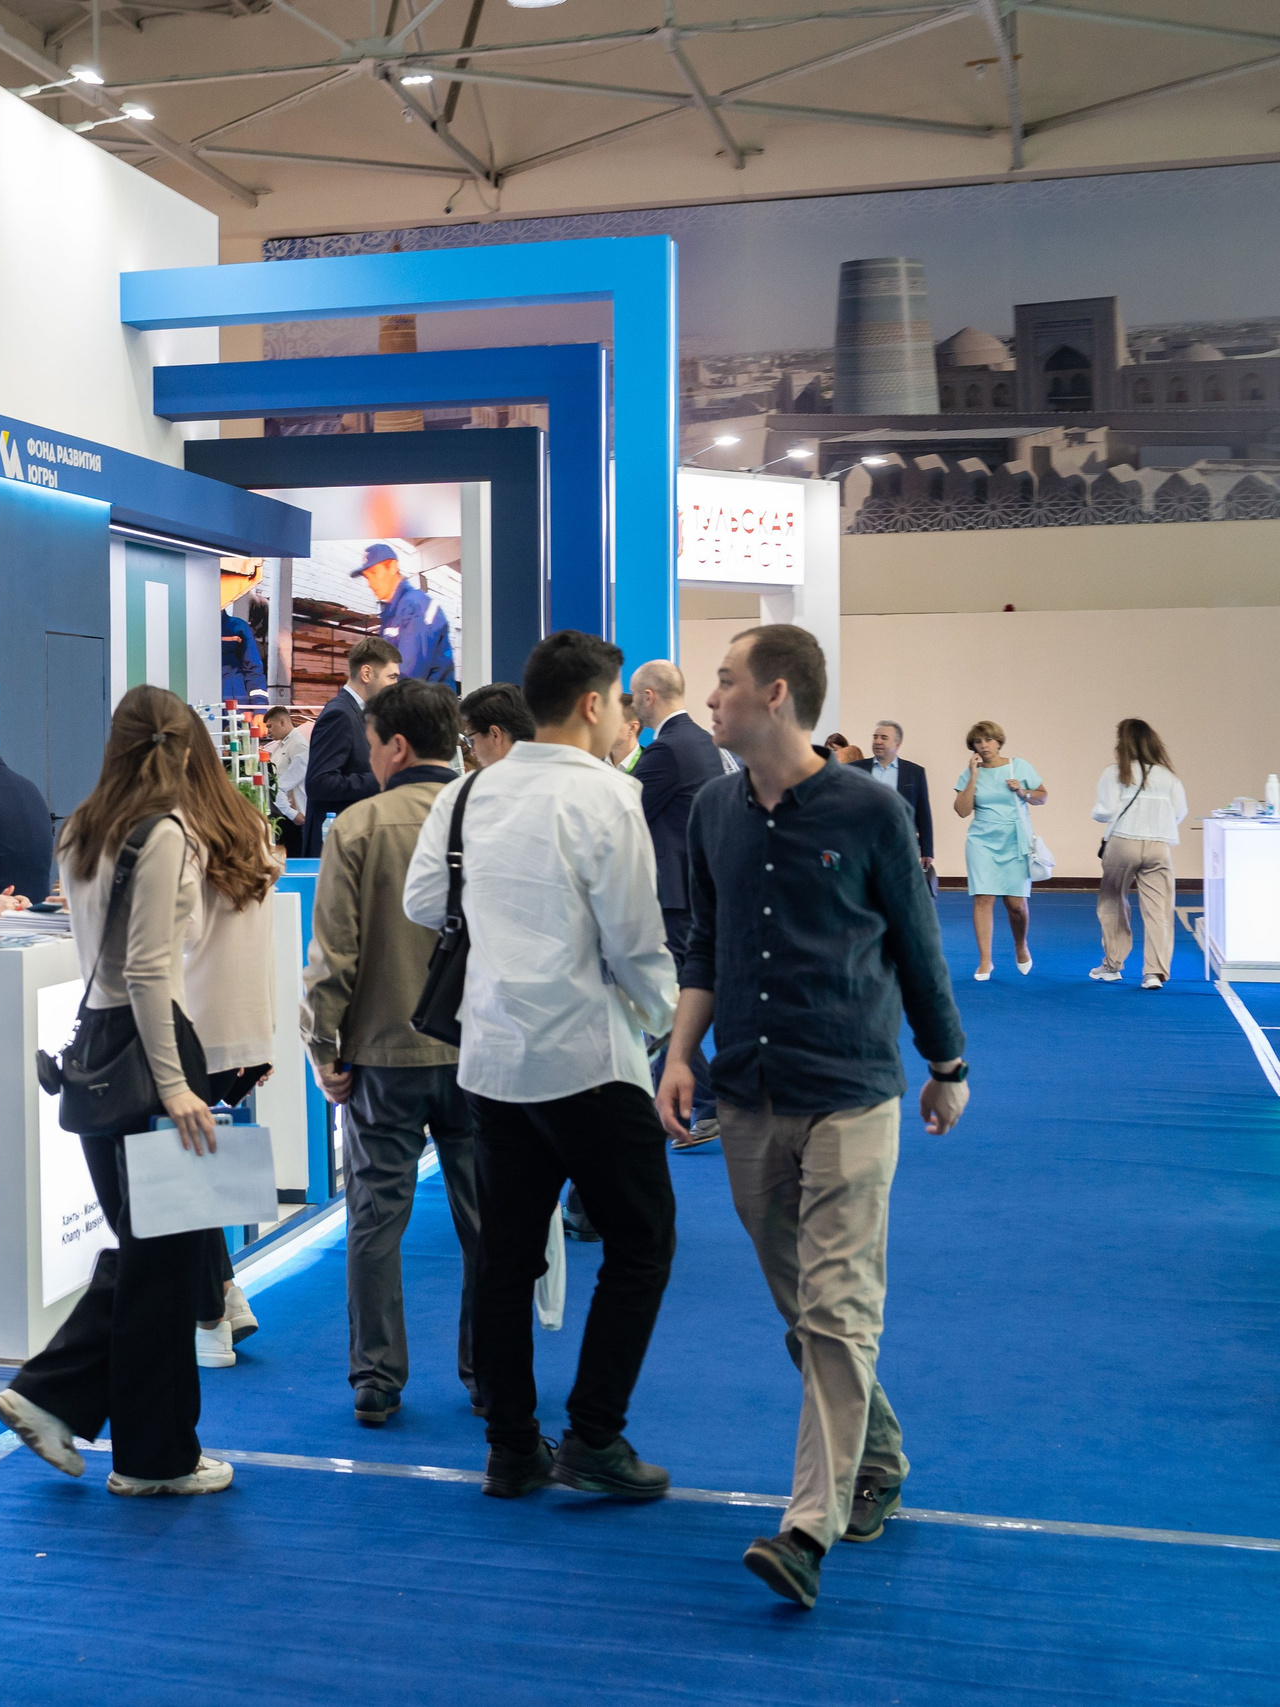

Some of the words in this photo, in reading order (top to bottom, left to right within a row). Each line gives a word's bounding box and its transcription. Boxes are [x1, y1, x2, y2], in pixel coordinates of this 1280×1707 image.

[27, 437, 56, 463] ФОНД
[57, 445, 102, 472] РАЗВИТИЯ
[27, 464, 58, 488] ЮГРЫ
[693, 505, 794, 536] ТУЛЬСКАЯ
